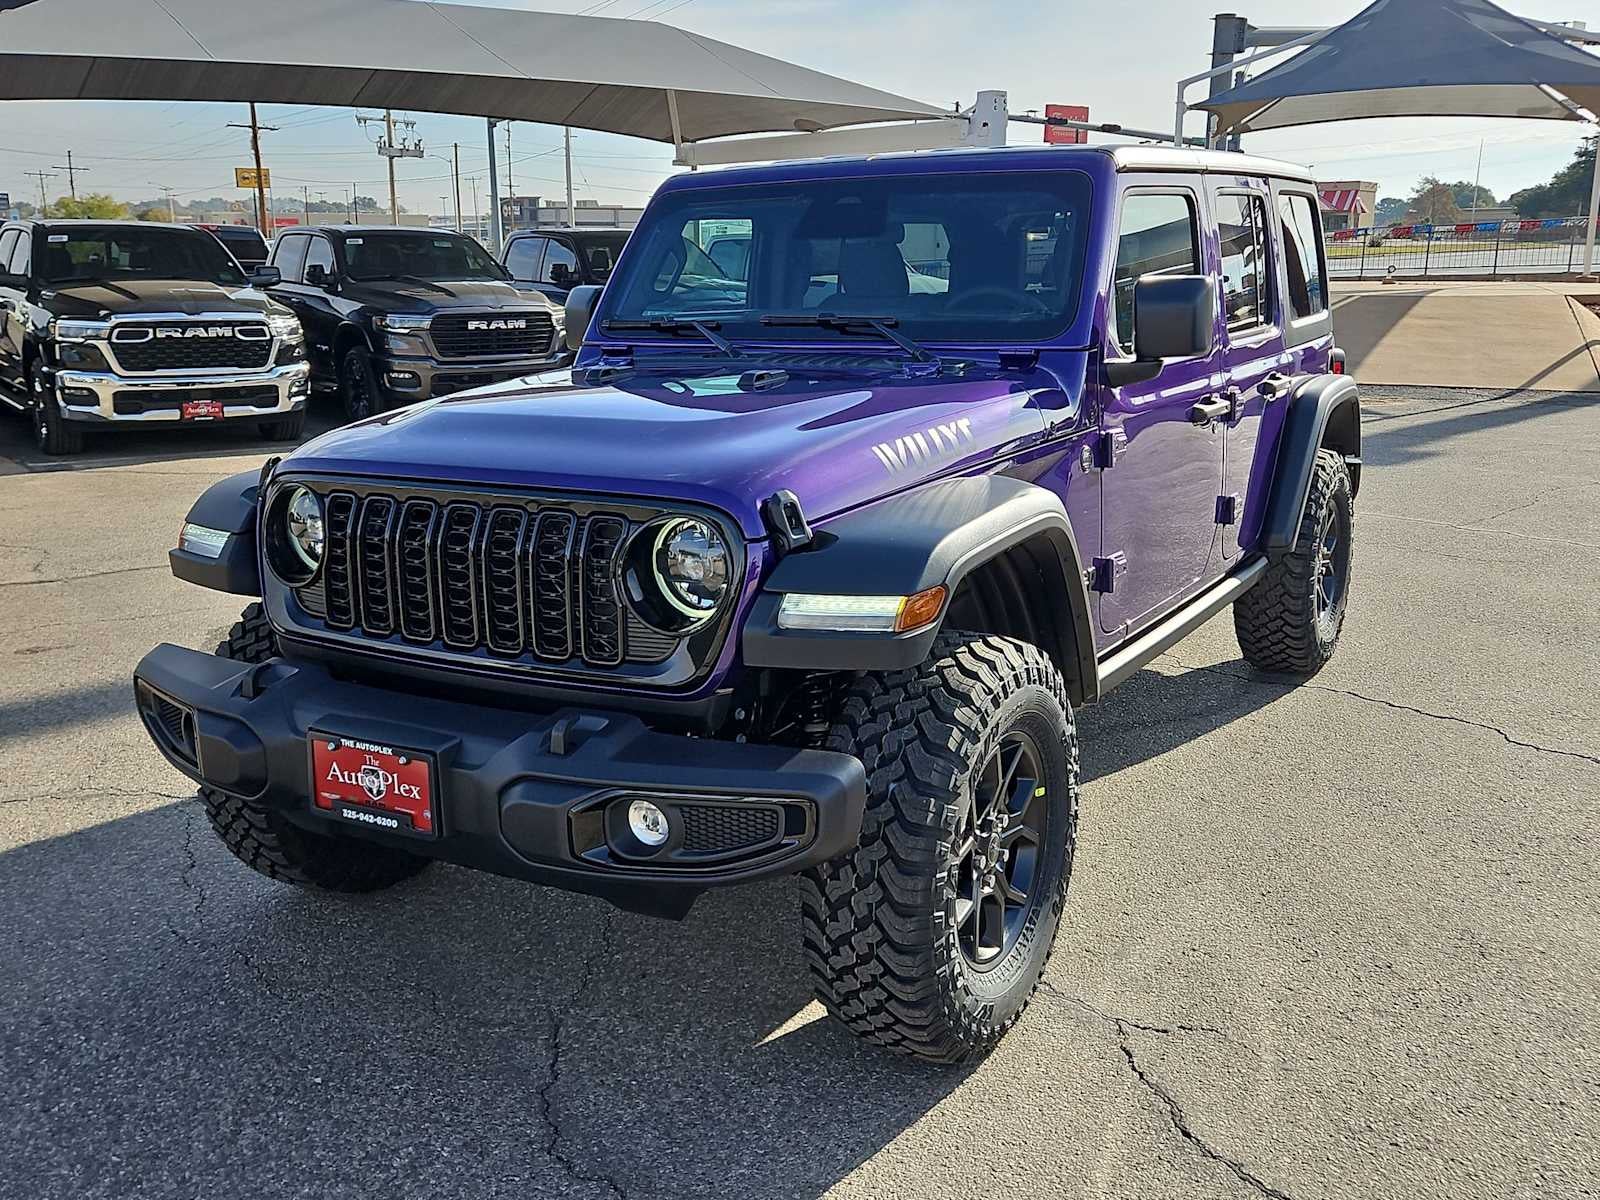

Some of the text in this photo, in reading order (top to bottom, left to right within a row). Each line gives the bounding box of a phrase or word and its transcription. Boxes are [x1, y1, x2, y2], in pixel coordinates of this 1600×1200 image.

[156, 326, 234, 338] RAM
[467, 319, 527, 330] RAM
[340, 738, 393, 756] THE AUTOPLEX
[363, 754, 380, 766] The
[326, 761, 422, 800] AutoPlex
[342, 808, 398, 828] 325-942-6200
